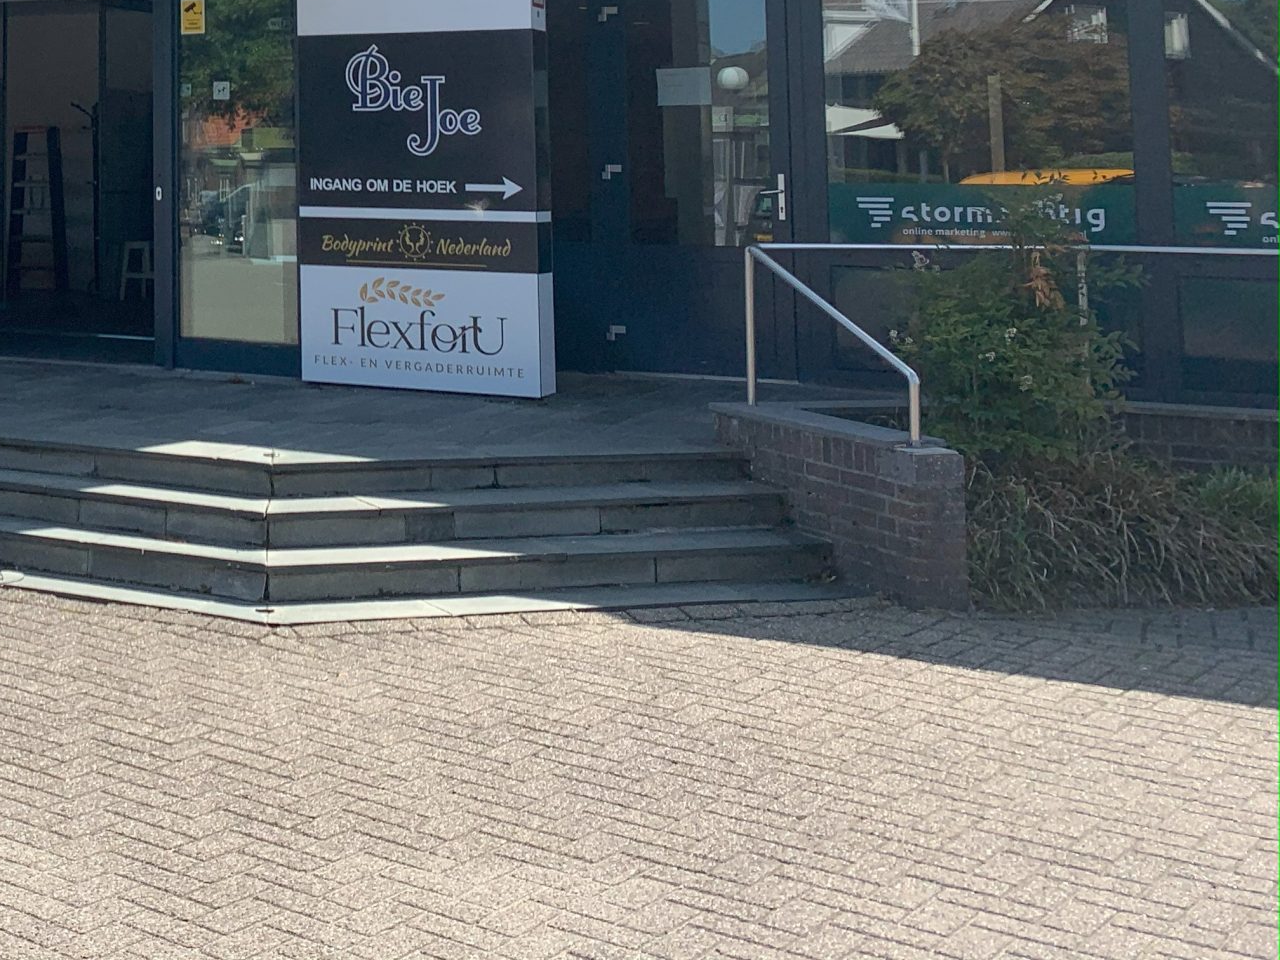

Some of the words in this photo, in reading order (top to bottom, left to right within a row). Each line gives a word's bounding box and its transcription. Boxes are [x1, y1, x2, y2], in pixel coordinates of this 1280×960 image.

[309, 177, 363, 191] INGANG
[366, 178, 389, 192] OM
[393, 179, 412, 193] DE
[416, 180, 457, 194] HOEK
[902, 227, 933, 236] online
[935, 227, 986, 238] marketing
[321, 233, 395, 257] Bodyprint
[436, 237, 512, 257] Nederland
[314, 354, 353, 367] FLEX-
[360, 357, 378, 368] EN
[384, 359, 525, 378] VERGADERRUIMTE
